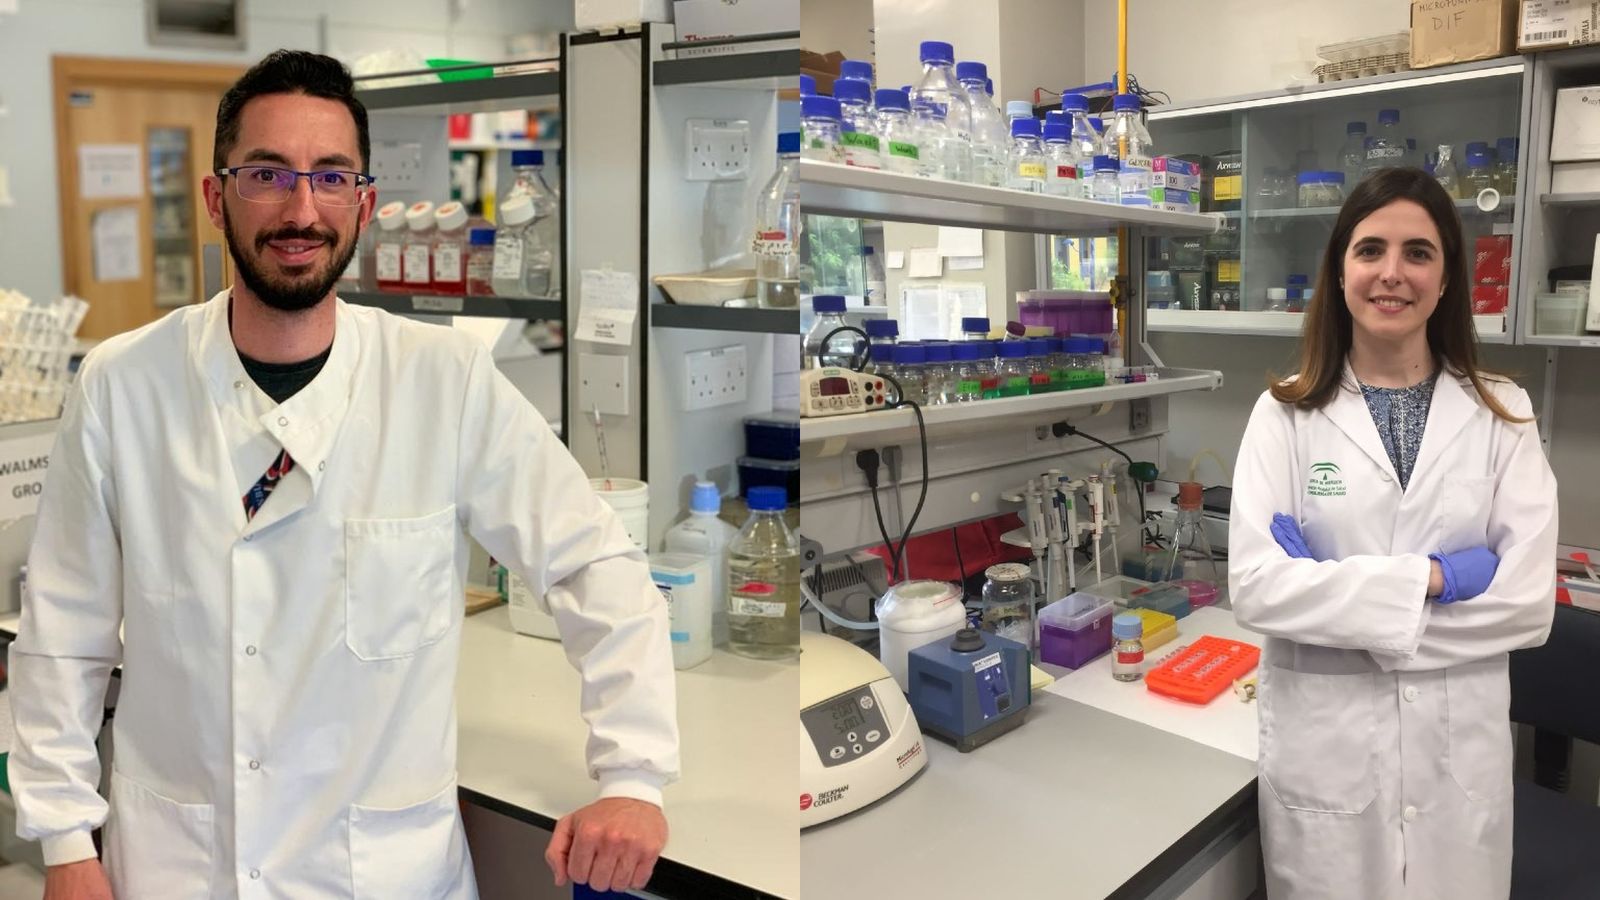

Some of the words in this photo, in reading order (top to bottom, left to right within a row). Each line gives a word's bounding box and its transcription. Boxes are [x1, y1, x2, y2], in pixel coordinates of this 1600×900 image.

[1432, 11, 1465, 30] DIF
[0, 454, 49, 476] WALMS
[12, 481, 42, 499] GRO
[813, 794, 843, 807] COULTER
[818, 784, 849, 800] BECKMAN
